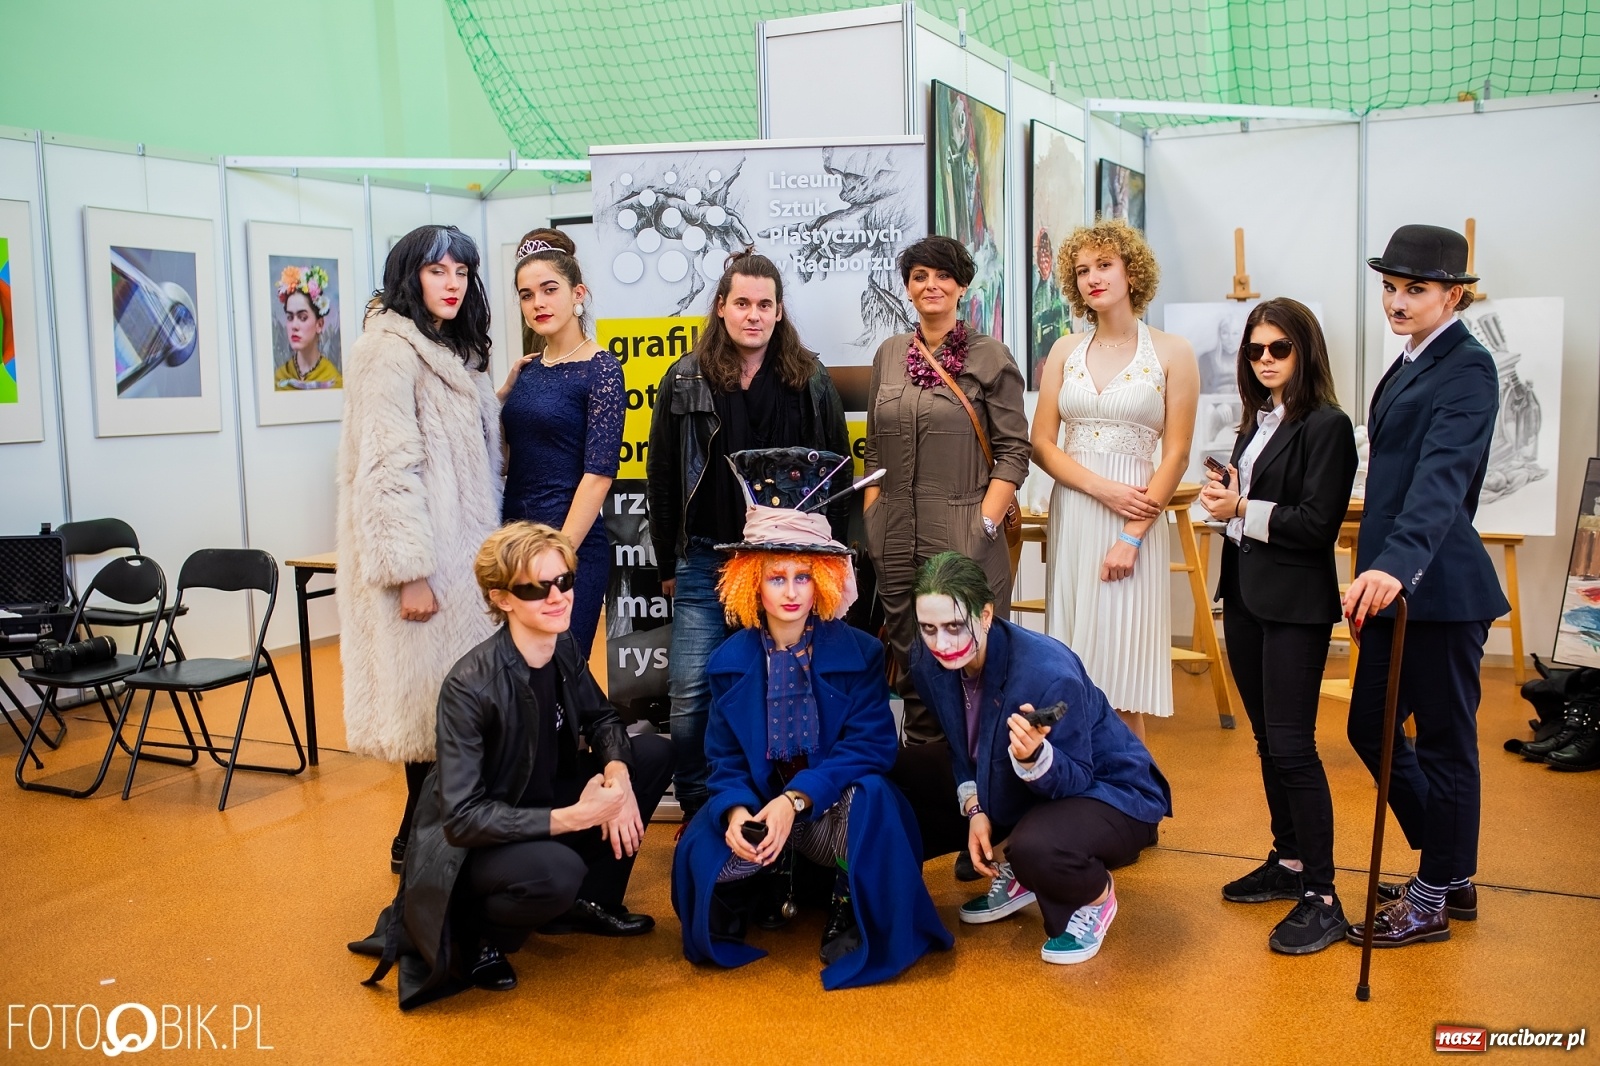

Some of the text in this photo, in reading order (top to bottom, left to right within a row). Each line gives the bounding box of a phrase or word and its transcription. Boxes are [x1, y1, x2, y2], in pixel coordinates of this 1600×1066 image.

[769, 171, 842, 189] Liceum
[769, 198, 828, 217] Sztuk
[770, 224, 902, 248] Plastycznych
[792, 254, 896, 273] Raciborzu
[618, 647, 669, 677] rys
